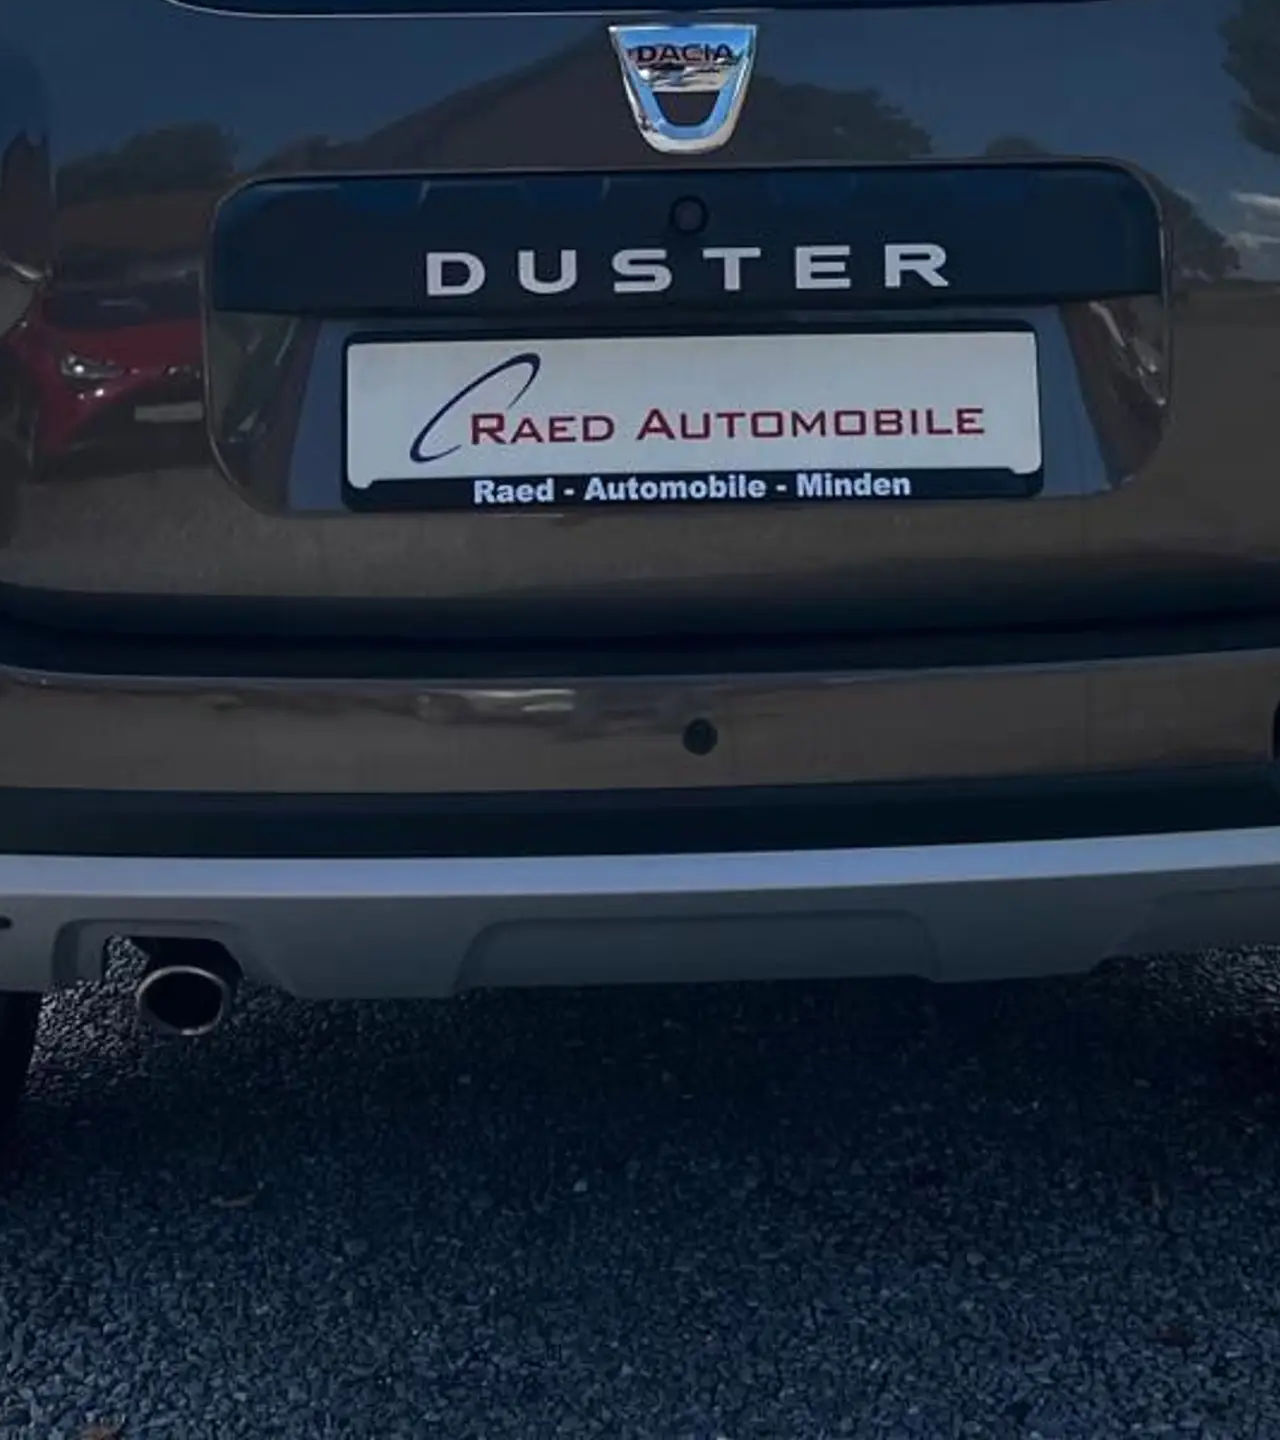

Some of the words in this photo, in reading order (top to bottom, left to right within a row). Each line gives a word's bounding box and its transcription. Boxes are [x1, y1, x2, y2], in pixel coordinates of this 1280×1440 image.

[636, 43, 734, 62] DACIA
[426, 244, 950, 297] DUSTER
[470, 412, 614, 445] RAED
[637, 408, 985, 441] AUTOMOBILE
[473, 478, 554, 505] Raed
[584, 474, 766, 502] Automobile
[796, 472, 911, 499] Minden
